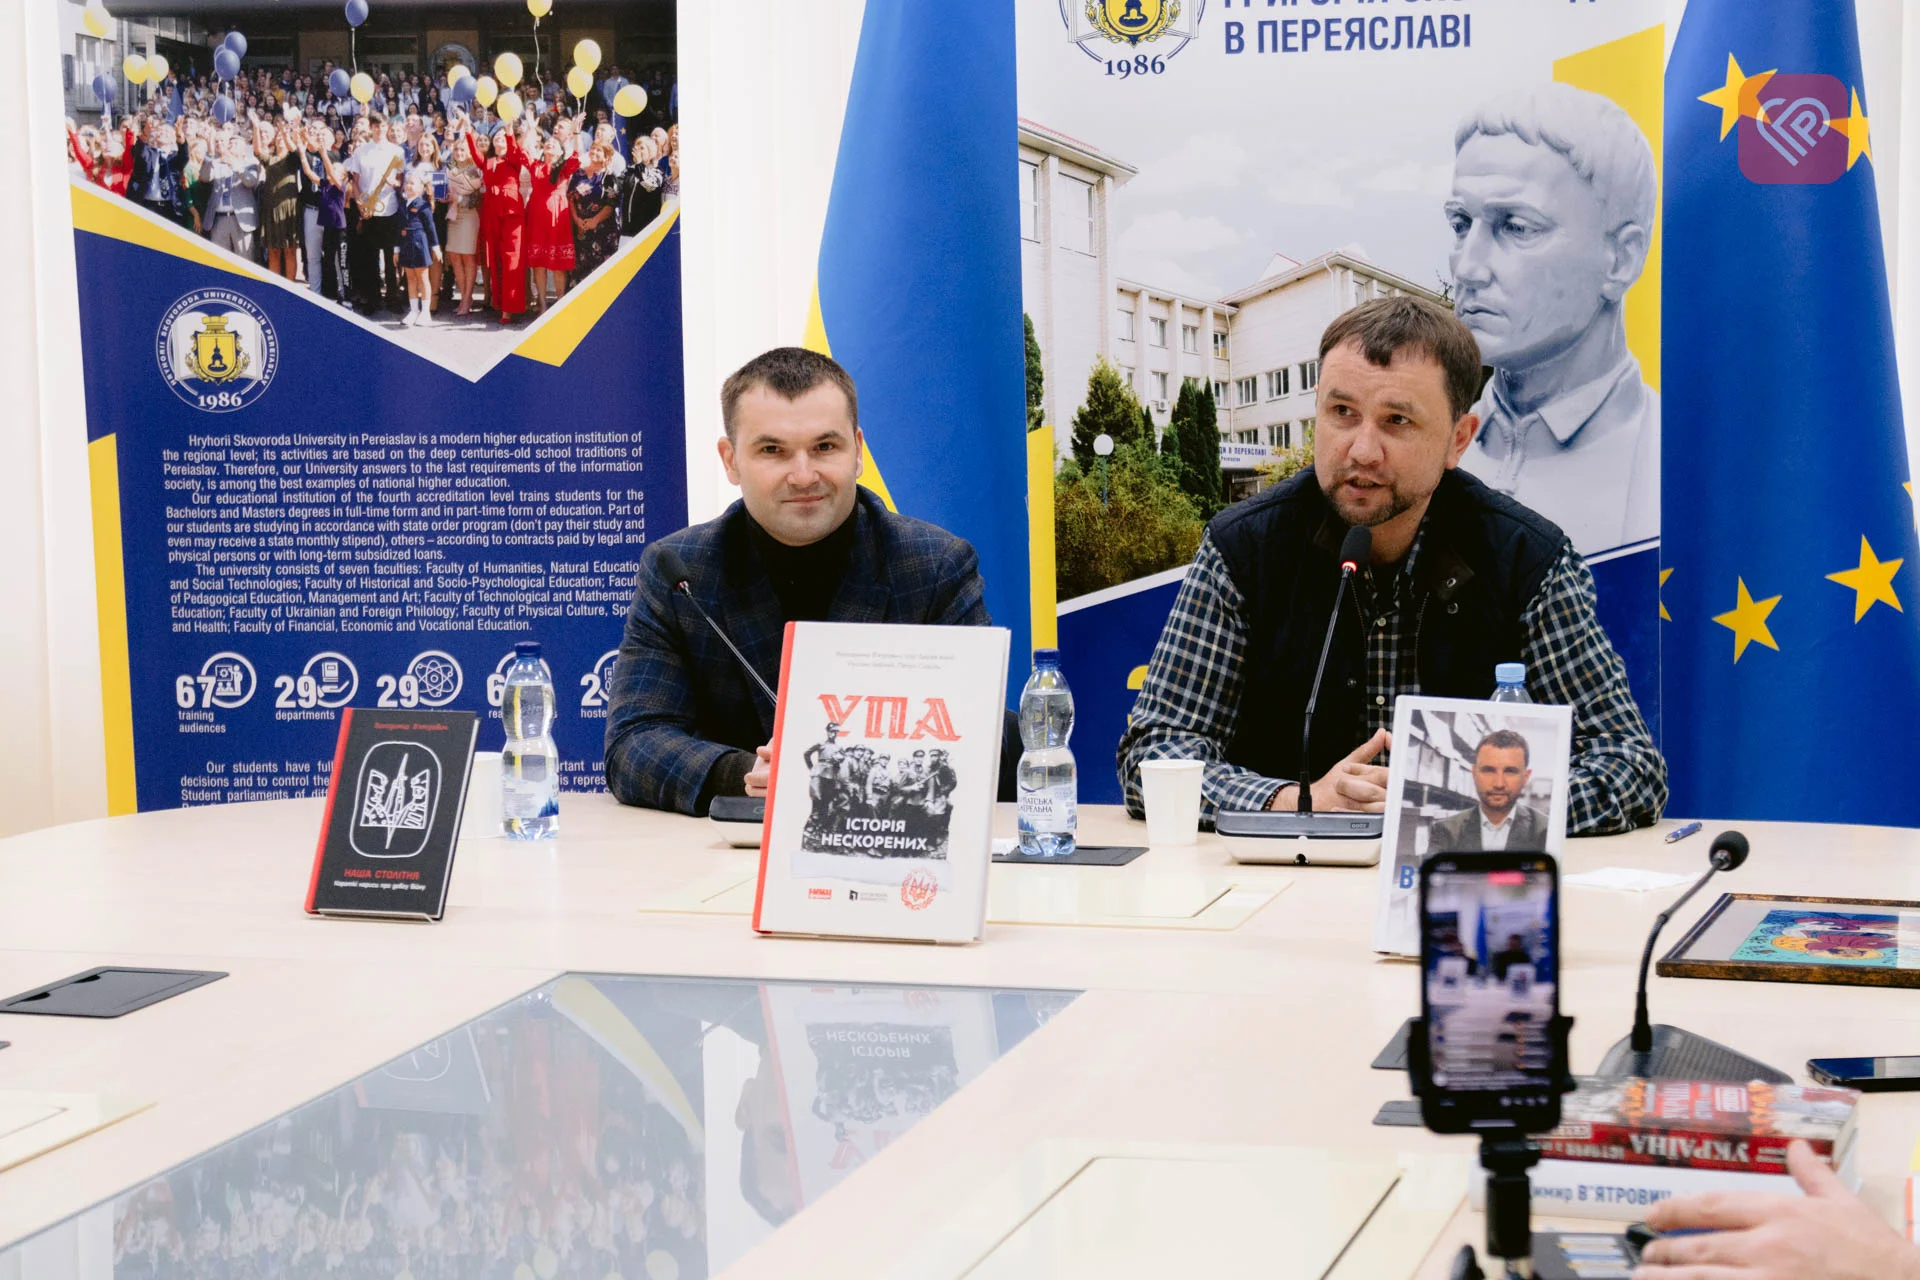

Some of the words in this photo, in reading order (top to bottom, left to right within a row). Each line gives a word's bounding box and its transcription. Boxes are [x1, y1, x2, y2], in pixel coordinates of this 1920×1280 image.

[1224, 21, 1245, 55] В
[1258, 13, 1471, 54] ПЕРЕЯСЛАВІ
[1103, 53, 1166, 80] 1986
[203, 291, 257, 313] UNIVERSITY
[257, 315, 267, 326] IN
[198, 391, 242, 409] 1986
[189, 434, 231, 448] Hryhorii
[234, 434, 291, 446] Skovoroda
[294, 433, 347, 448] University
[349, 433, 359, 445] in
[361, 433, 416, 444] Pereiaslav
[419, 432, 428, 444] is
[430, 435, 437, 444] a
[440, 432, 481, 444] modern
[484, 432, 517, 446] higher
[520, 432, 572, 443] education
[575, 431, 628, 443] institution
[631, 431, 642, 443] of
[163, 449, 179, 461] the
[184, 449, 225, 463] regional
[230, 449, 258, 462] level;
[263, 449, 276, 460] its
[281, 448, 328, 460] activities
[332, 451, 349, 459] are
[354, 448, 385, 459] based
[390, 450, 404, 459] on
[408, 448, 426, 459] the
[430, 447, 456, 461] deep
[461, 447, 530, 458] centuries-old
[535, 446, 571, 458] school
[576, 446, 627, 458] traditions
[632, 446, 642, 457] of
[164, 463, 219, 475] Pereiaslav.
[224, 463, 278, 477] Therefore,
[283, 465, 301, 474] our
[305, 462, 358, 476] University
[362, 464, 407, 474] answers
[410, 462, 422, 473] to
[426, 461, 443, 473] the
[447, 461, 466, 473] last
[470, 461, 540, 475] requirements
[544, 460, 555, 472] of
[559, 460, 576, 472] the
[581, 460, 643, 472] information
[165, 478, 204, 492] society,
[208, 478, 216, 489] is
[220, 480, 256, 492] among
[260, 478, 276, 489] the
[280, 478, 302, 489] best
[306, 477, 356, 491] examples
[359, 477, 369, 488] of
[372, 477, 415, 488] national
[418, 476, 452, 490] higher
[455, 476, 510, 487] education.
[192, 493, 210, 504] Our
[216, 493, 277, 504] educational
[283, 492, 336, 503] institution
[341, 492, 351, 503] of
[356, 492, 373, 503] the
[378, 492, 411, 502] fourth
[416, 491, 485, 502] accreditation
[490, 491, 514, 502] level
[519, 491, 550, 502] trains
[555, 490, 601, 501] students
[606, 490, 621, 501] for
[627, 490, 644, 501] the
[168, 551, 210, 564] physical
[214, 553, 256, 564] persons
[259, 553, 270, 561] or
[274, 550, 296, 561] with
[300, 550, 352, 563] long-term
[355, 550, 411, 560] subsidized
[414, 549, 445, 560] loans.
[197, 565, 215, 575] The
[220, 564, 271, 578] university
[276, 564, 320, 575] consists
[324, 564, 334, 574] of
[339, 566, 369, 574] seven
[374, 563, 421, 574] faculties:
[426, 563, 464, 576] Faculty
[468, 563, 479, 573] of
[483, 562, 546, 576] Humanities,
[550, 562, 589, 573] Natural
[593, 562, 639, 572] Educatio
[170, 579, 189, 590] and
[192, 579, 224, 590] Social
[228, 578, 301, 592] Technologies;
[305, 578, 342, 591] Faculty
[346, 578, 356, 589] of
[360, 577, 410, 589] Historical
[414, 577, 434, 588] and
[437, 576, 545, 590] Socio-Psychological
[549, 576, 604, 590] Education;
[609, 576, 637, 587] Facul
[172, 621, 191, 633] and
[194, 621, 230, 635] Health;
[234, 621, 272, 634] Faculty
[274, 621, 285, 632] of
[288, 620, 338, 634] Financial,
[341, 620, 393, 631] Economic
[396, 620, 416, 631] and
[418, 619, 474, 631] Vocational
[477, 619, 532, 630] Education.
[176, 674, 216, 708] 67
[274, 675, 318, 708] 29
[376, 674, 419, 708] 29
[580, 673, 602, 706] 2
[178, 711, 214, 722] training
[275, 710, 335, 723] departments
[581, 708, 607, 719] hoste
[817, 694, 962, 741] УПА
[179, 722, 226, 734] audiences
[206, 761, 225, 773] Our
[232, 761, 278, 773] students
[285, 760, 310, 773] have
[560, 760, 585, 772] rtant
[181, 775, 229, 787] decisions
[233, 775, 253, 787] and
[257, 776, 268, 787] to
[272, 774, 309, 787] control
[573, 775, 606, 787] repres
[181, 789, 221, 801] Student
[227, 788, 289, 801] parliaments
[845, 817, 906, 833] ІСТОРІЯ
[821, 833, 927, 850] НЕСКОРЕНИХ
[344, 868, 371, 878] НАША
[1629, 1133, 1751, 1163] УКРАЇНА
